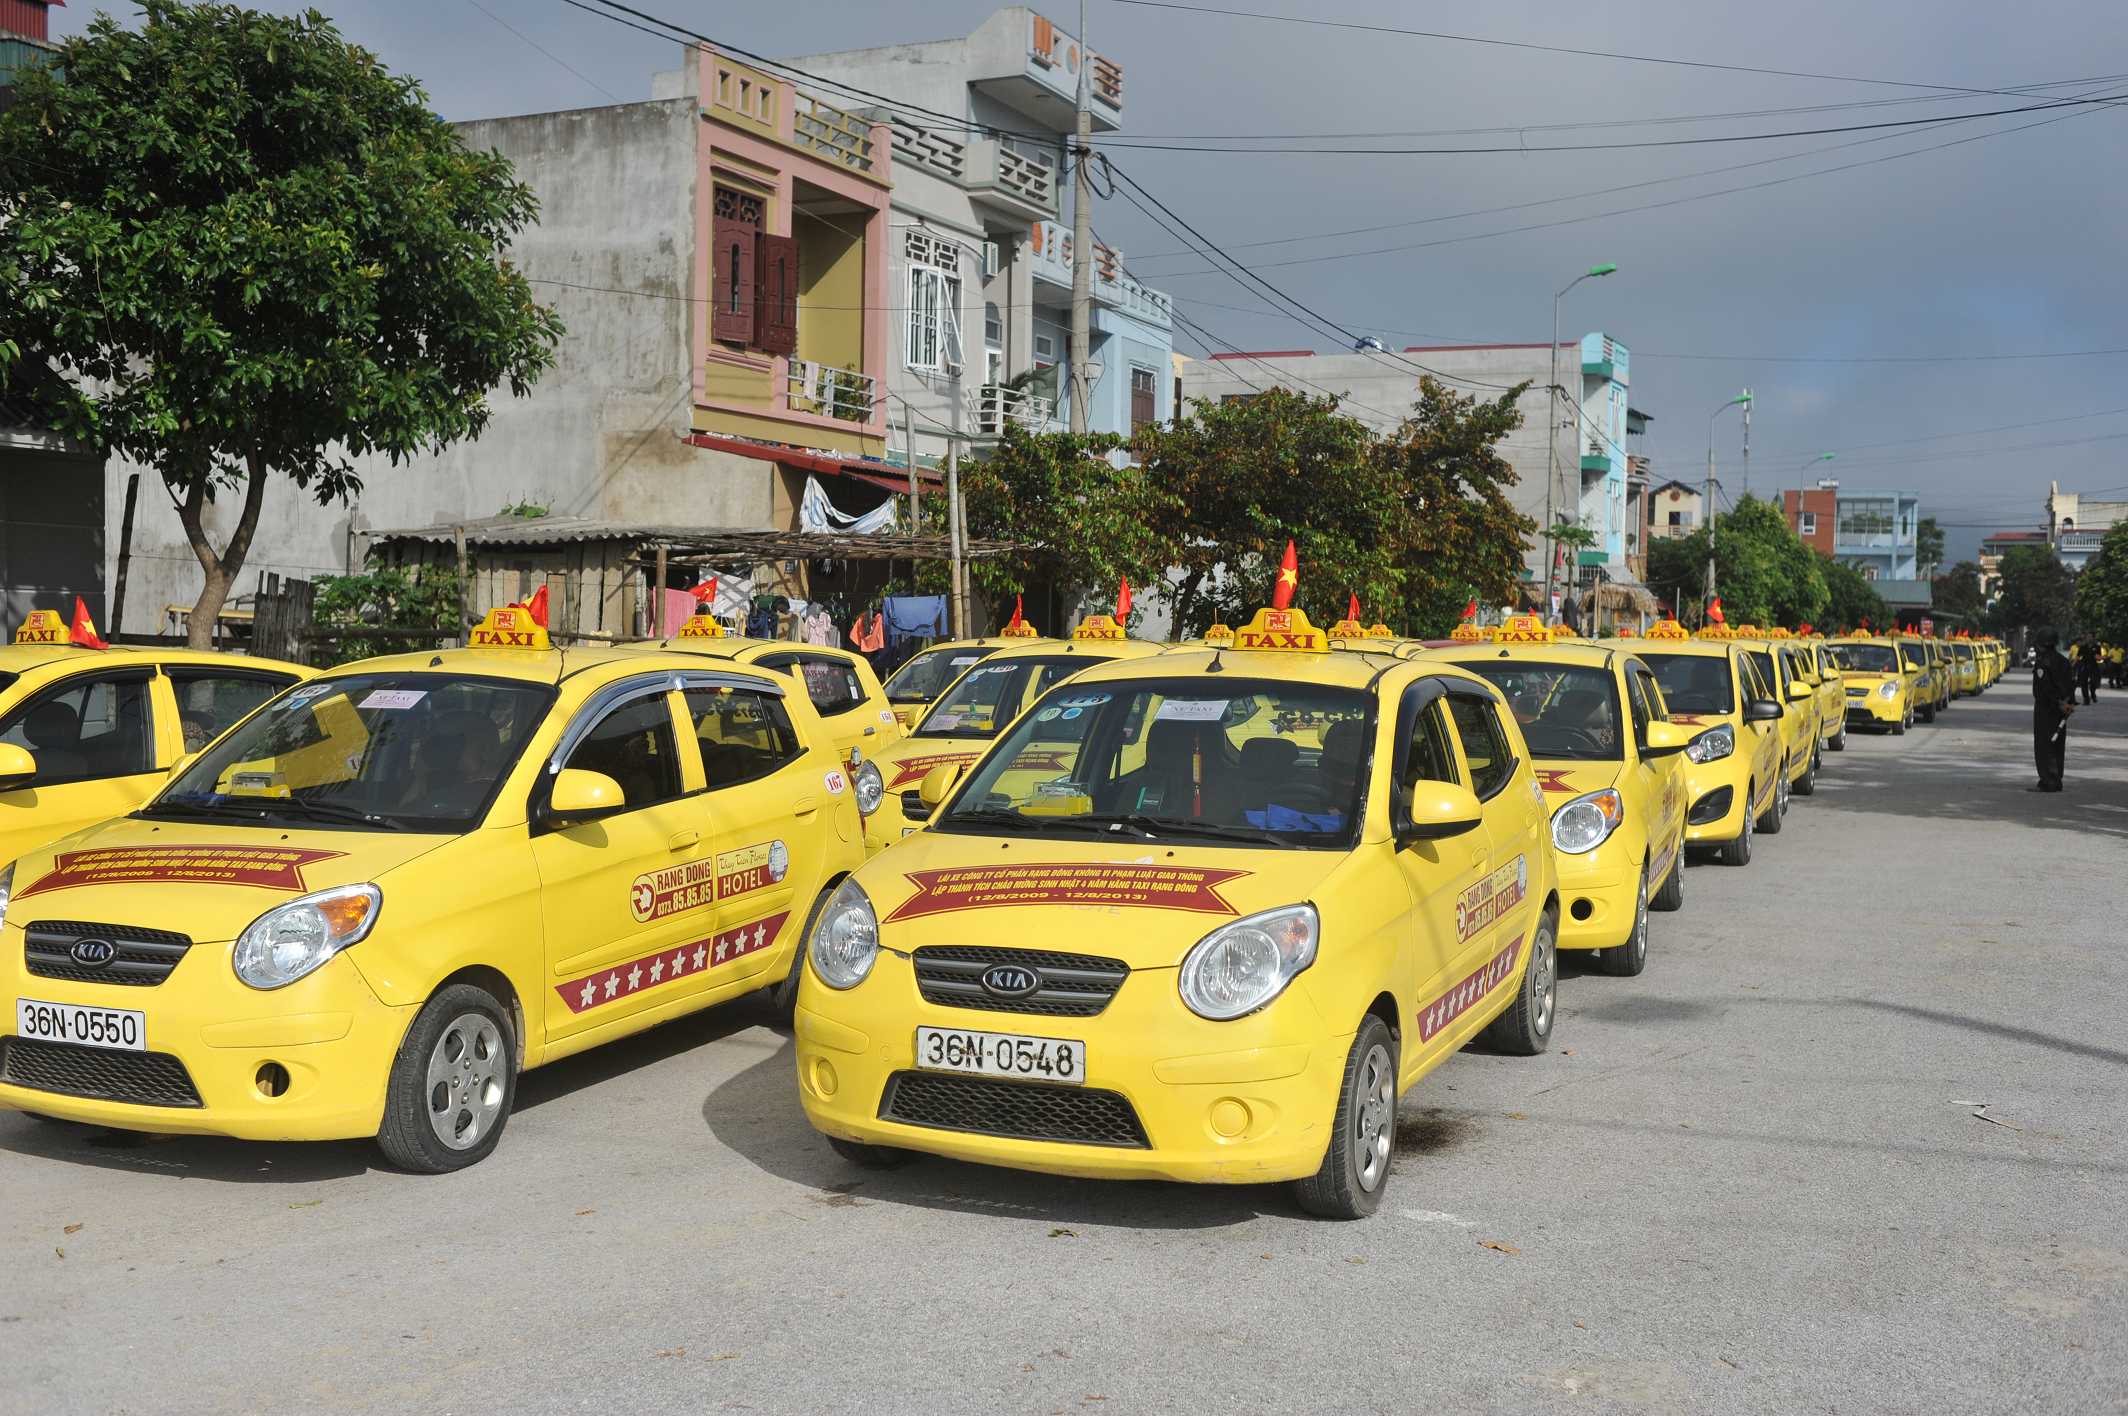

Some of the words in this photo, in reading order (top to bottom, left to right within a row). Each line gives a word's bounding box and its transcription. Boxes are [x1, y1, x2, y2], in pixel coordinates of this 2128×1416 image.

[18, 630, 56, 642] TAXI
[475, 631, 535, 646] TAXI
[682, 629, 717, 637] TAXI
[1077, 630, 1118, 639] TAXI
[1333, 630, 1364, 638] TAXI
[1499, 632, 1549, 641] TAXI
[1241, 633, 1316, 649] TAXI
[827, 774, 843, 791] 167
[657, 868, 684, 892] RANG
[686, 861, 711, 882] DONG
[961, 871, 984, 881] CÔNG
[1156, 871, 1177, 880] GIAO
[723, 868, 763, 897] HOTEL
[1037, 880, 1059, 888] SINH
[1131, 881, 1151, 890] TAXI
[968, 892, 1049, 902] (12/8/2009
[1066, 892, 1148, 901] 12/8/2013)
[77, 944, 105, 960] KIA
[991, 971, 1027, 989] KIA
